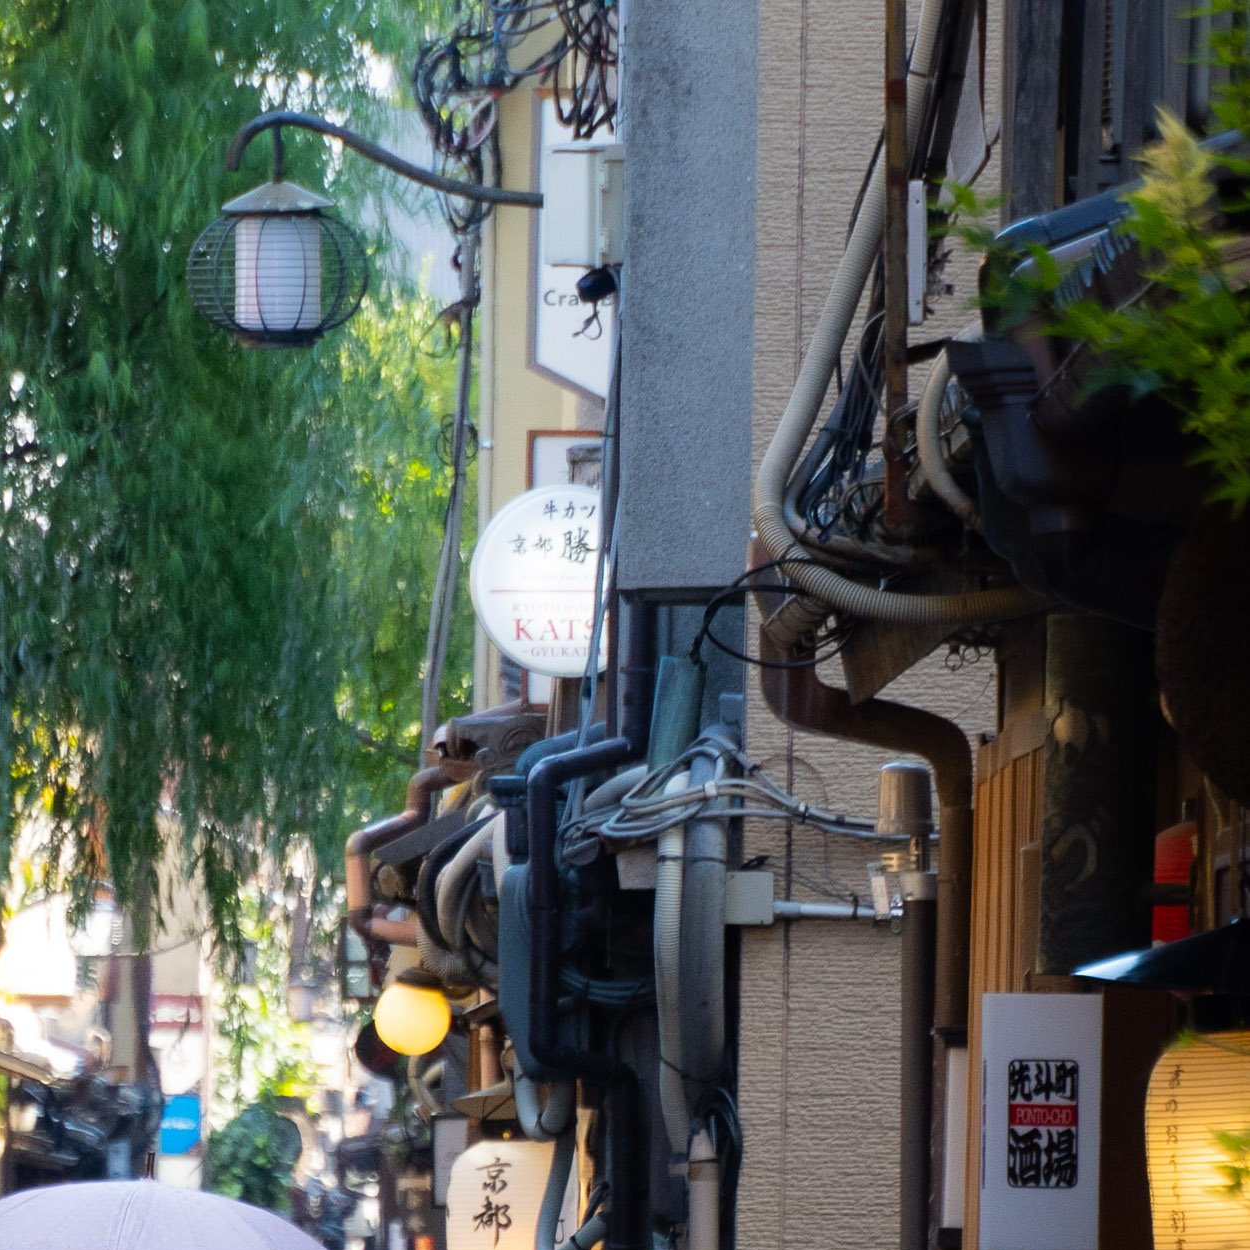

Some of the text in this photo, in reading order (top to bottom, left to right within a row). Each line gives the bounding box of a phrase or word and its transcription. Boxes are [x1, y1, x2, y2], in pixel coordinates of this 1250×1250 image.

[543, 500, 596, 520] 牛カツ
[513, 618, 592, 642] KATS
[1009, 1061, 1077, 1102] 先斗町
[1015, 1107, 1072, 1124] PONTO-CHO
[1009, 1128, 1077, 1187] 酒場
